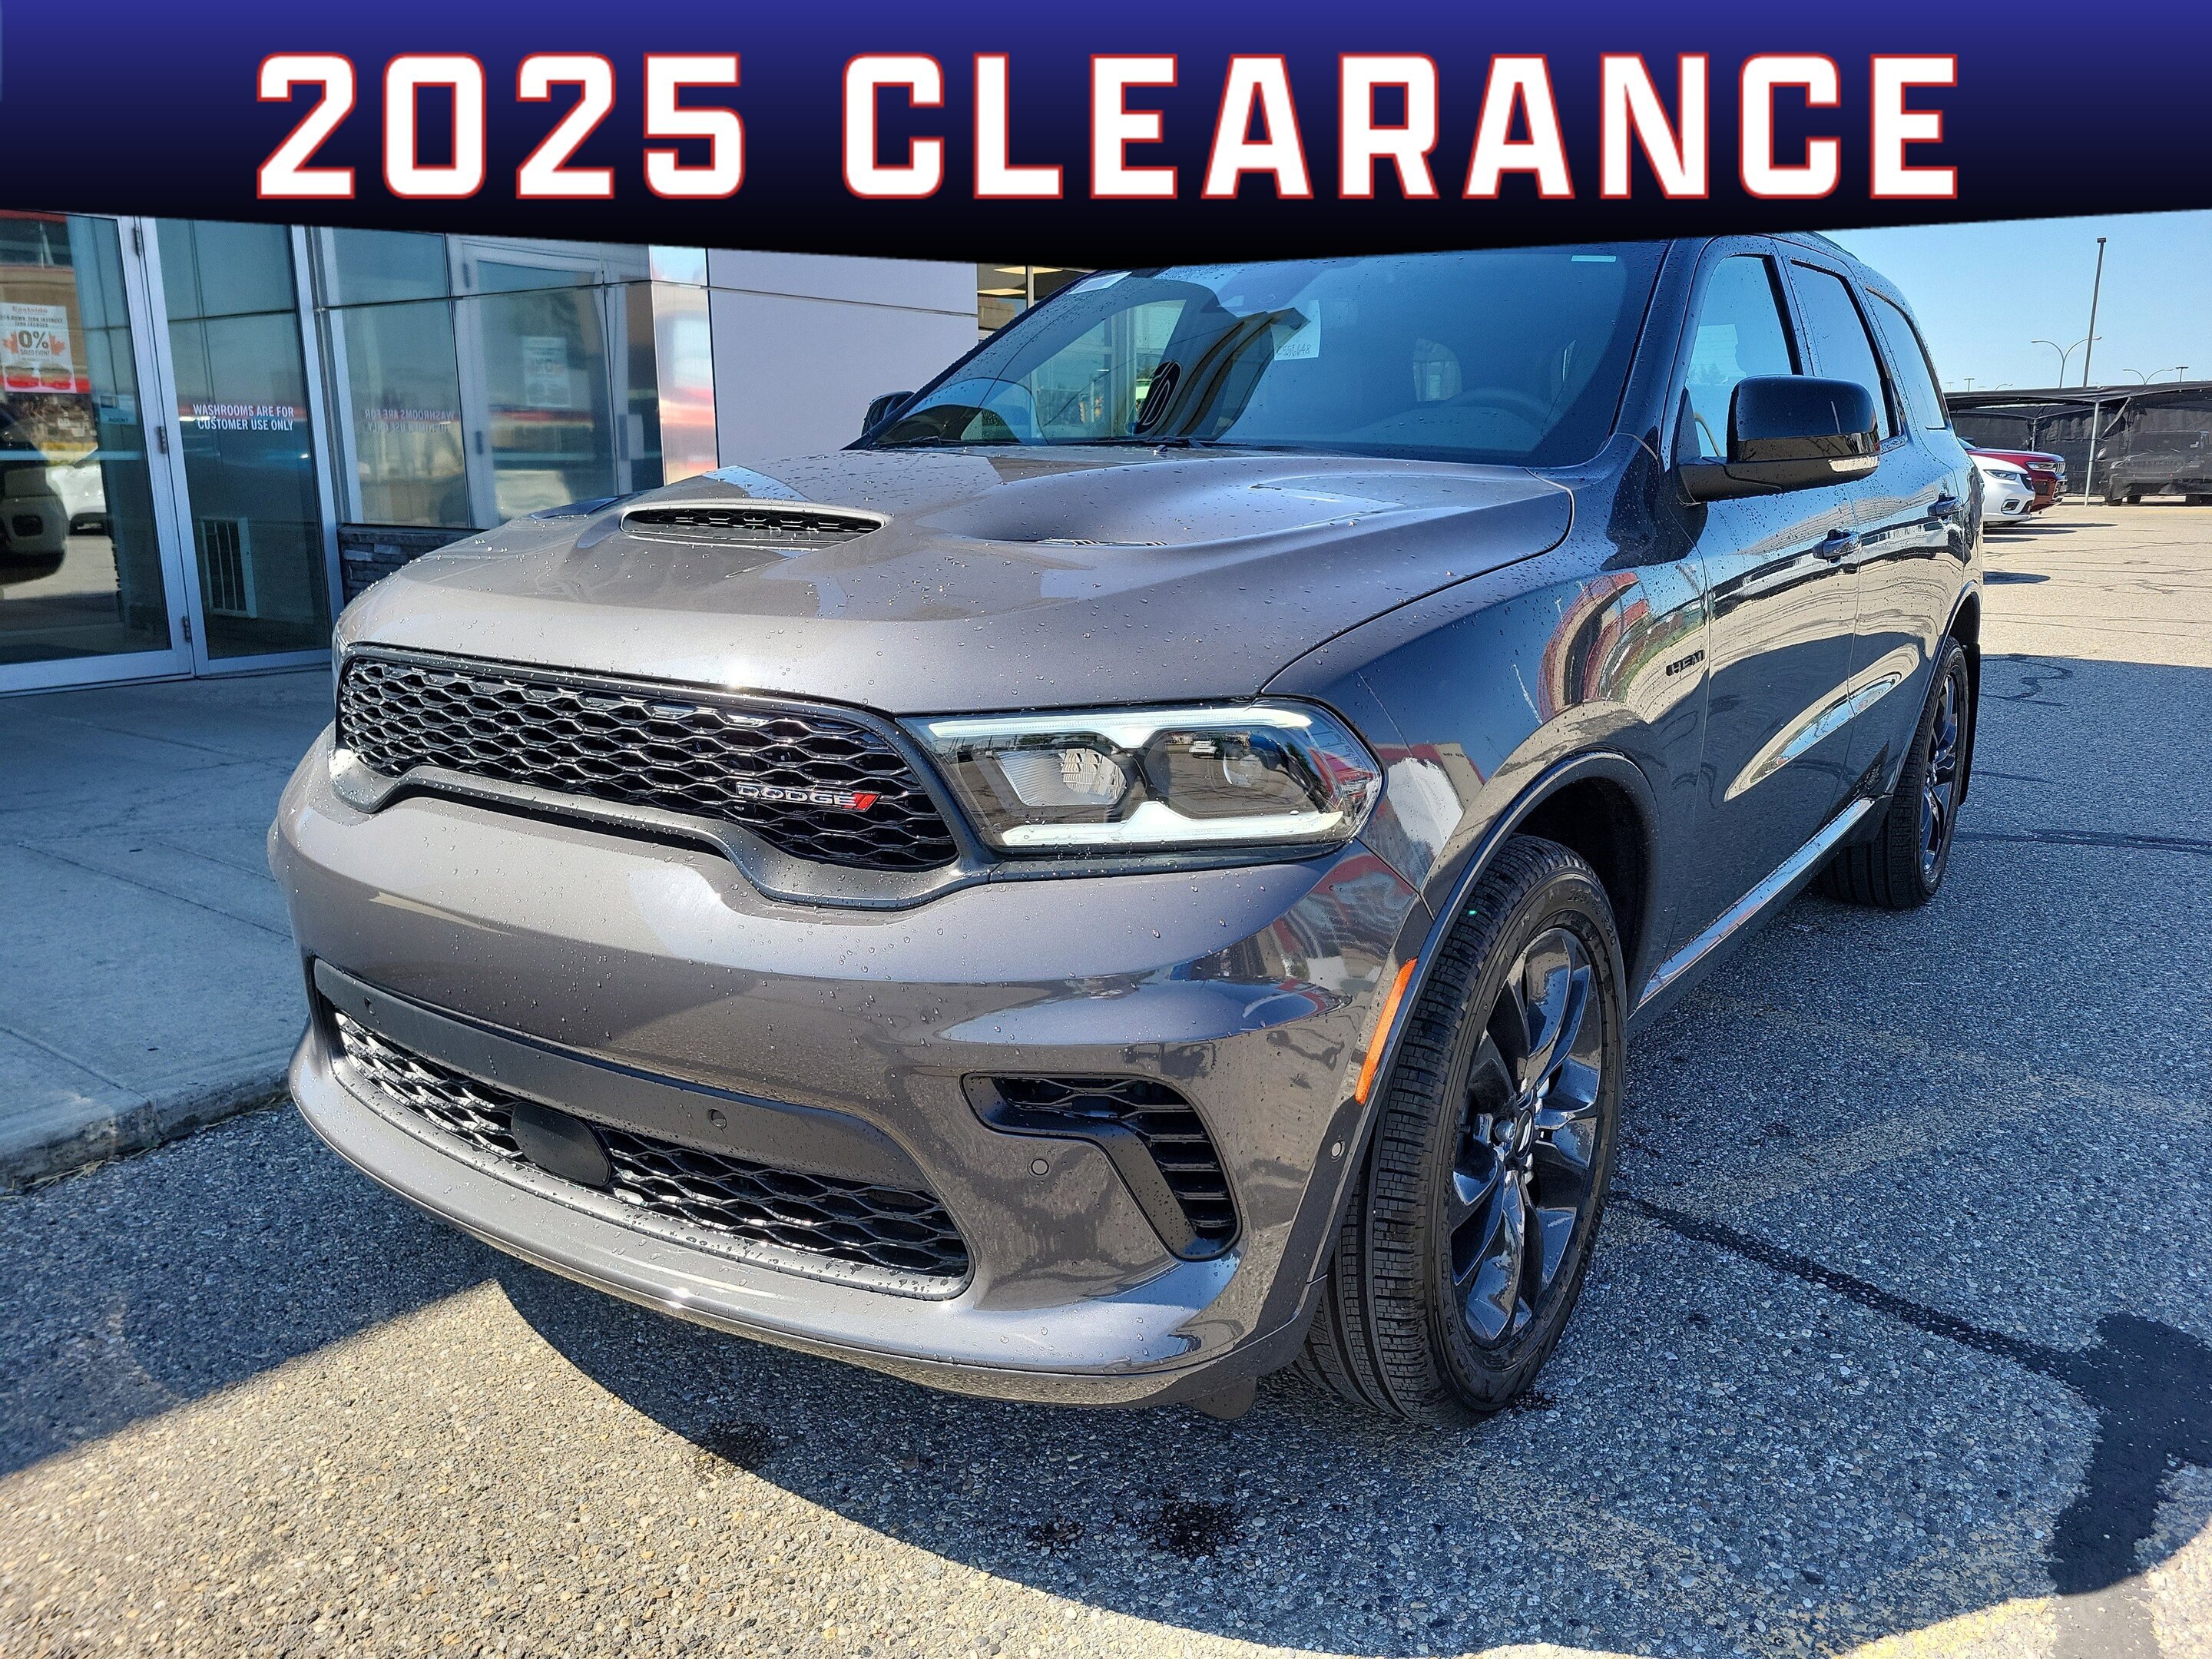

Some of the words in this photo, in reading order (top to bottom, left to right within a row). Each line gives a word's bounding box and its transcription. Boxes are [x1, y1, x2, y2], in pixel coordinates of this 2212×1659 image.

[18, 330, 48, 349] 0%
[193, 403, 254, 417] WASHROOMS
[257, 406, 275, 417] ARE
[276, 406, 294, 418] FOR
[197, 418, 249, 430] CUSTOMER
[251, 419, 269, 430] USE
[271, 419, 293, 431] ONLY
[737, 784, 857, 806] DODGE
